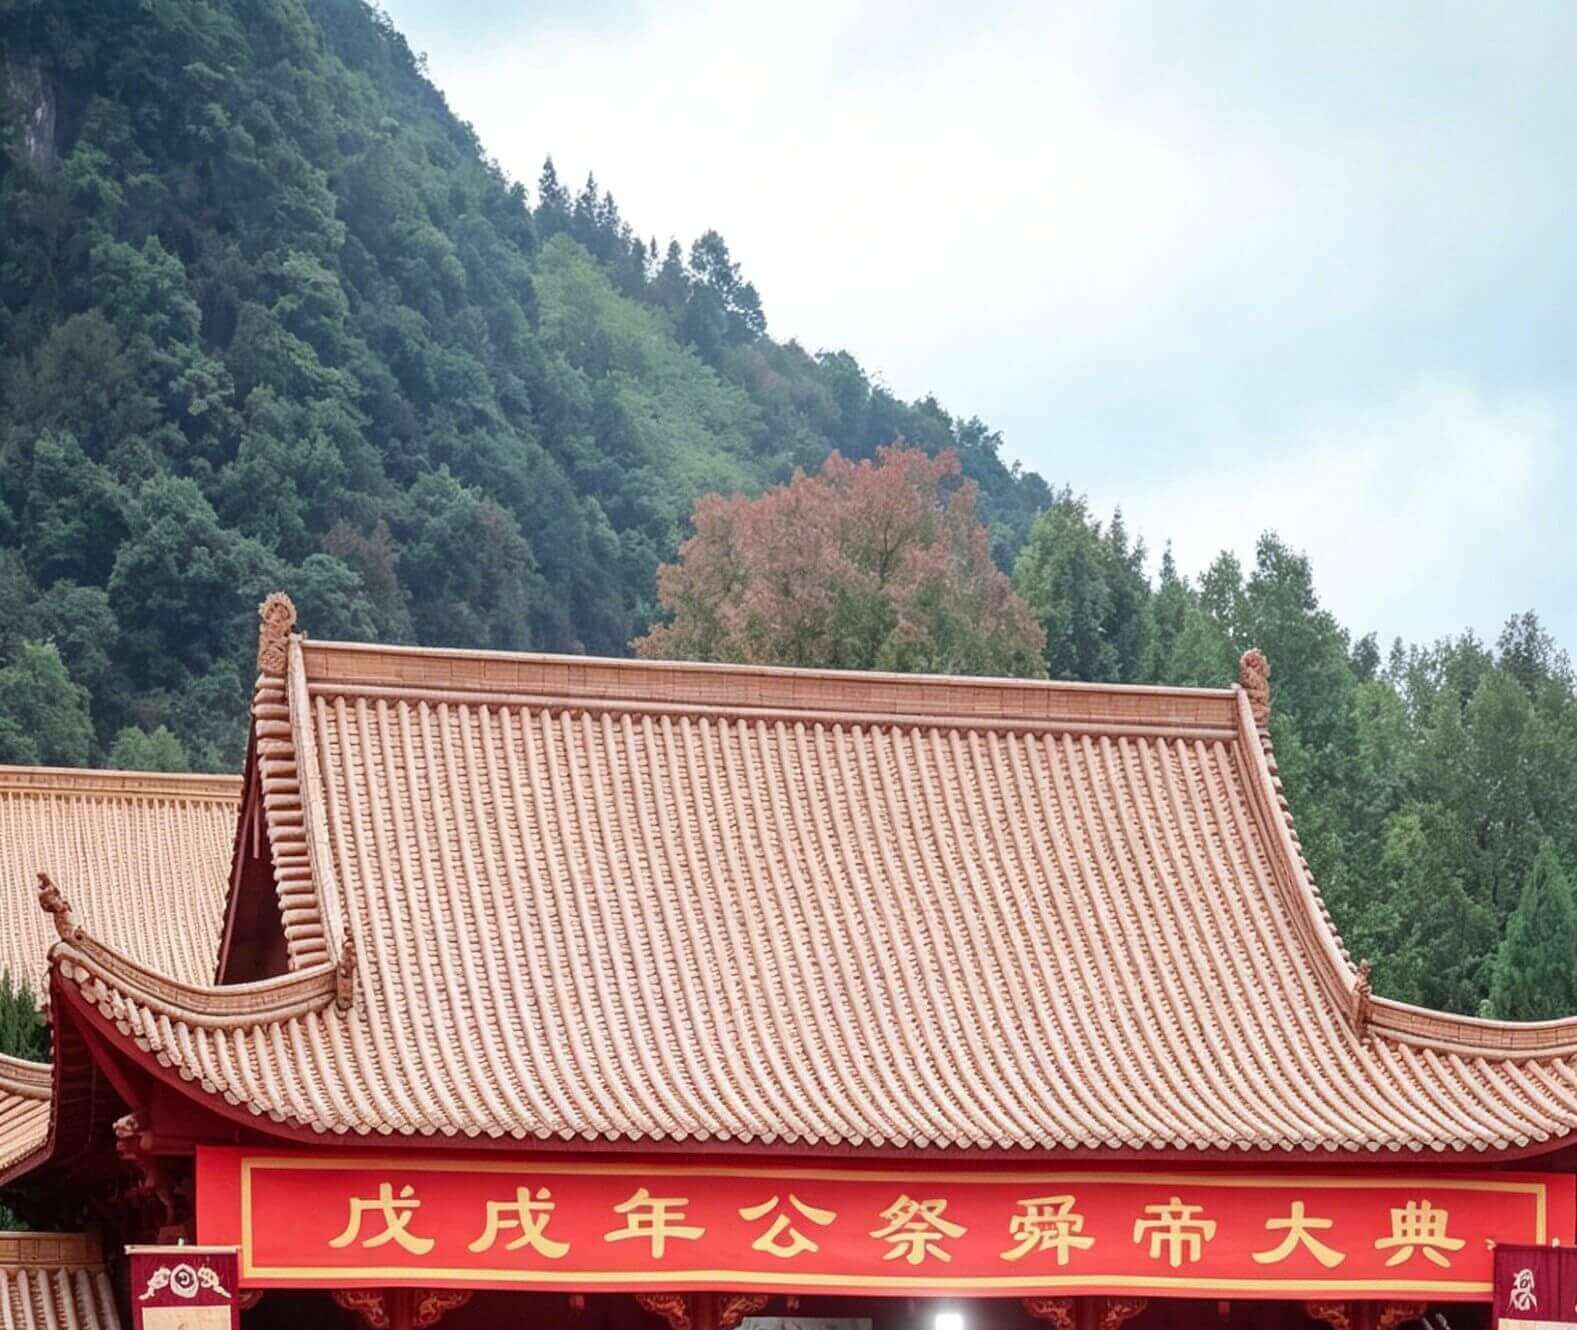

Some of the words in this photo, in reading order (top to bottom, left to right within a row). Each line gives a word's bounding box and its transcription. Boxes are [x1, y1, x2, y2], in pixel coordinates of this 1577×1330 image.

[328, 1182, 1466, 1268] 戊戌年公祭舜帝大典
